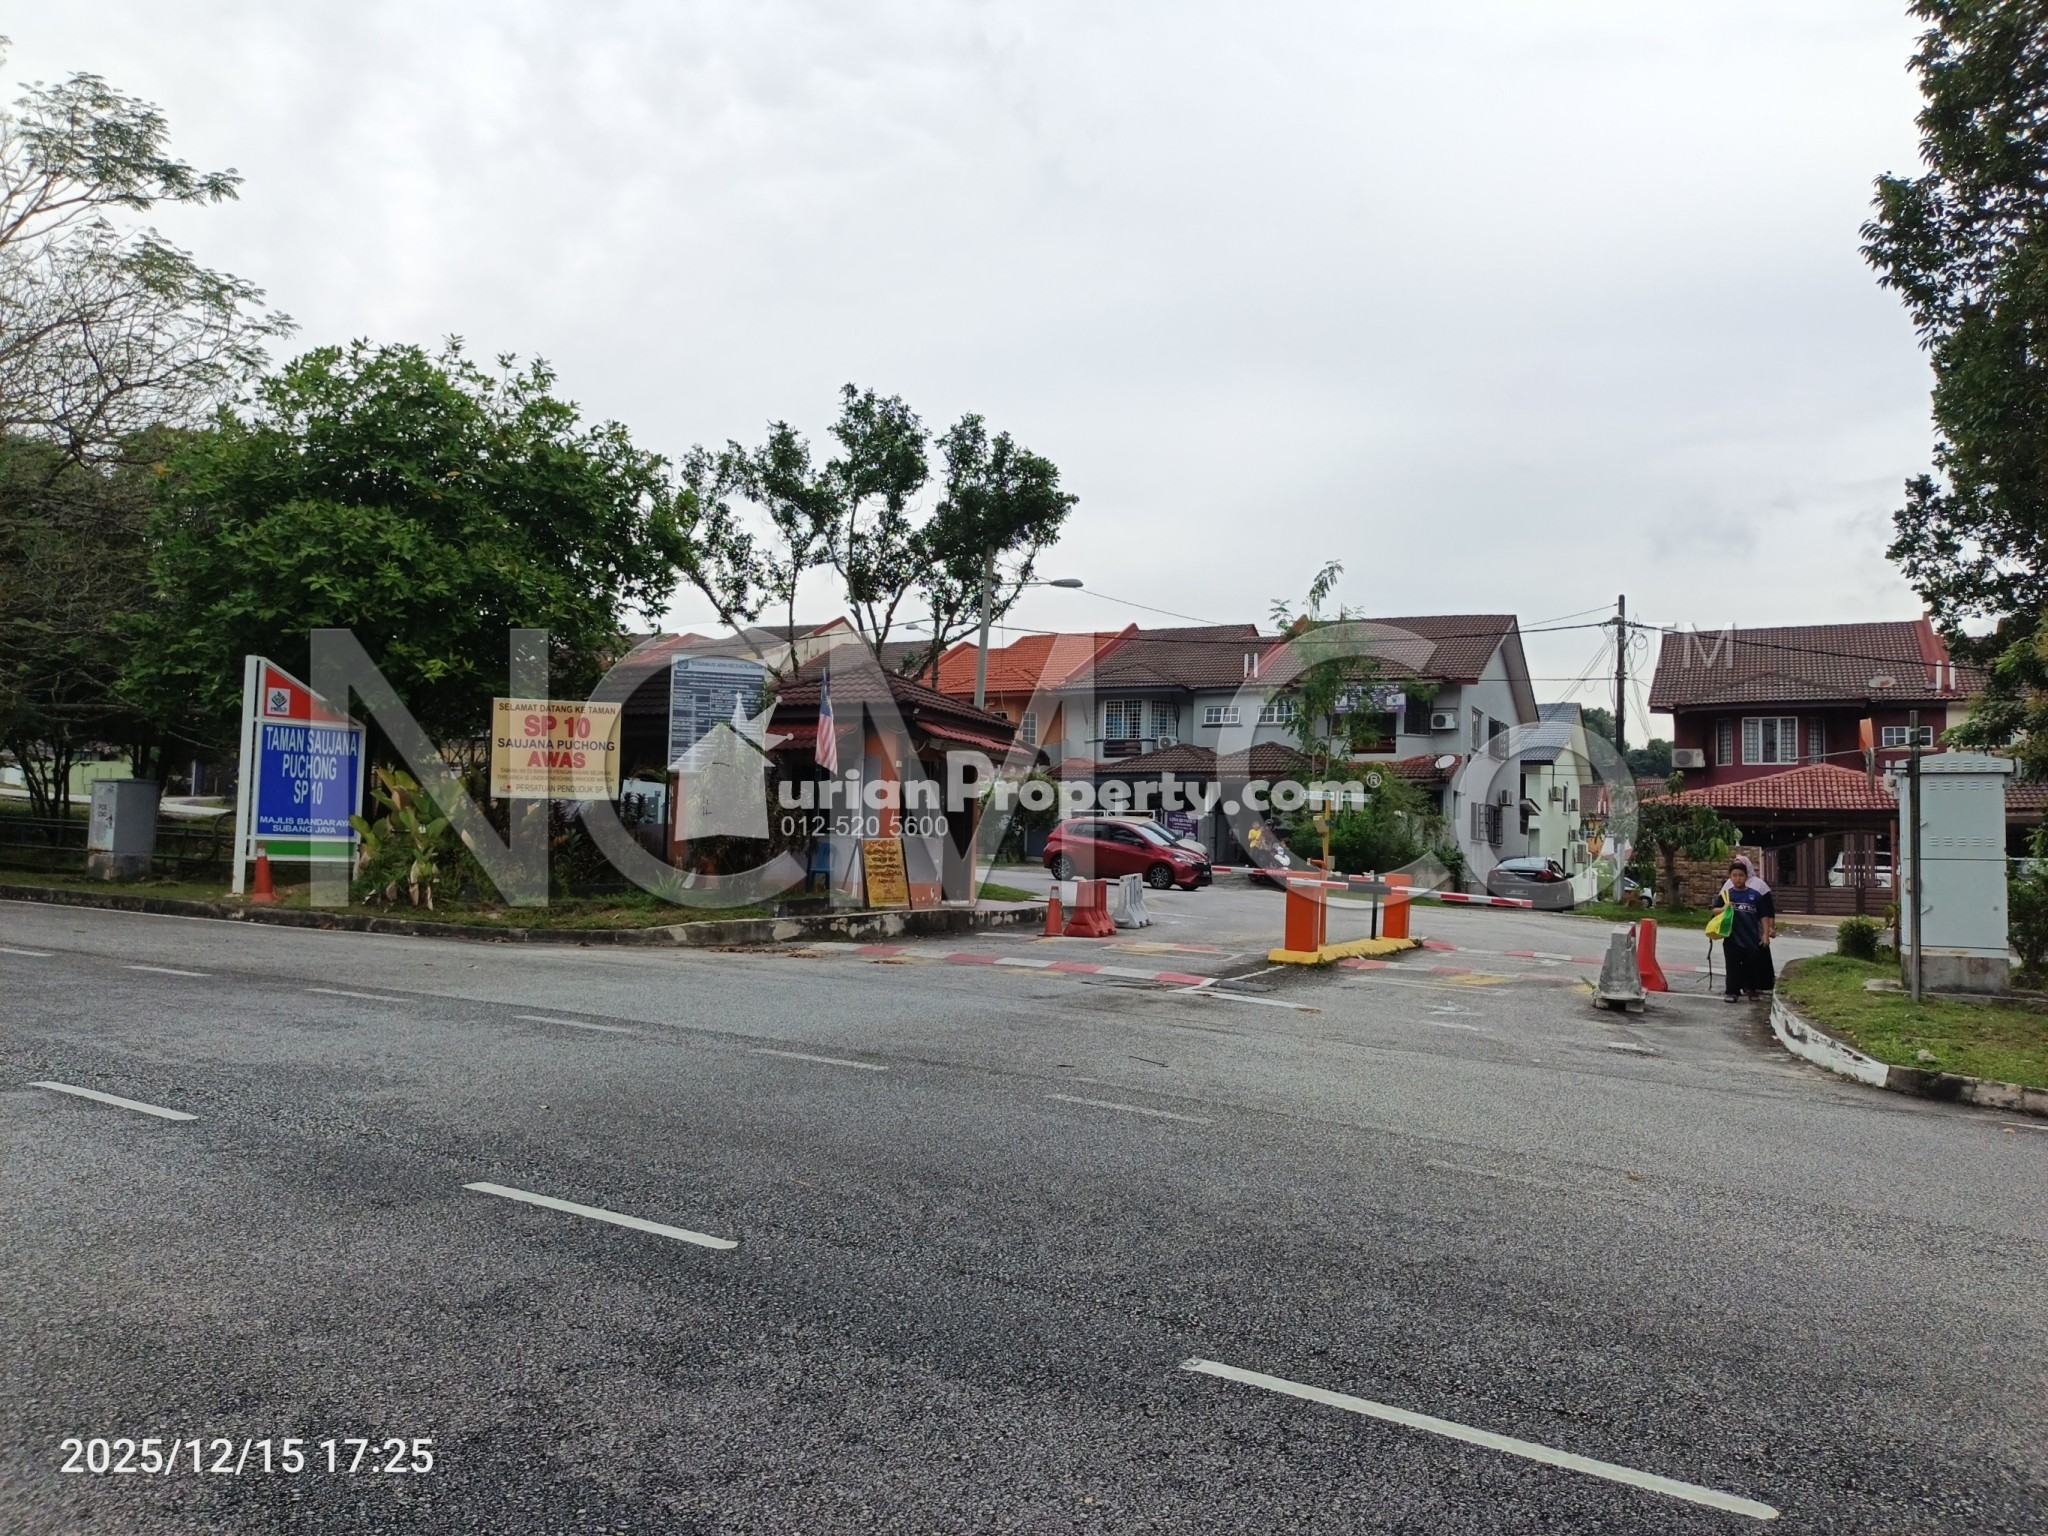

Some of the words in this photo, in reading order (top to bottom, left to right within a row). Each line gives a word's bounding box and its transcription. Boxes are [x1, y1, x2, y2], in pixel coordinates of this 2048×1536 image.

[499, 702, 538, 712] SELAMAT
[540, 704, 573, 714] DATANG
[575, 705, 586, 714] KE
[588, 706, 616, 715] TAMAN
[524, 714, 557, 737] SP
[564, 716, 591, 738] 10
[267, 726, 305, 752] TAMAN
[307, 730, 357, 756] SAUJANA
[498, 738, 554, 749] SAUJANA
[557, 740, 615, 751] PUCHONG
[282, 753, 337, 780] PUCHONG
[527, 751, 586, 769] AWAS
[293, 779, 309, 804] SP
[311, 781, 323, 805] 10
[516, 784, 556, 792] PERSATUAN
[557, 785, 594, 793] PENDUDUK
[260, 815, 294, 825] MAJLIS
[297, 817, 352, 827] BANDARAYA
[273, 825, 312, 833] SUBANG
[315, 826, 336, 834] JAYA
